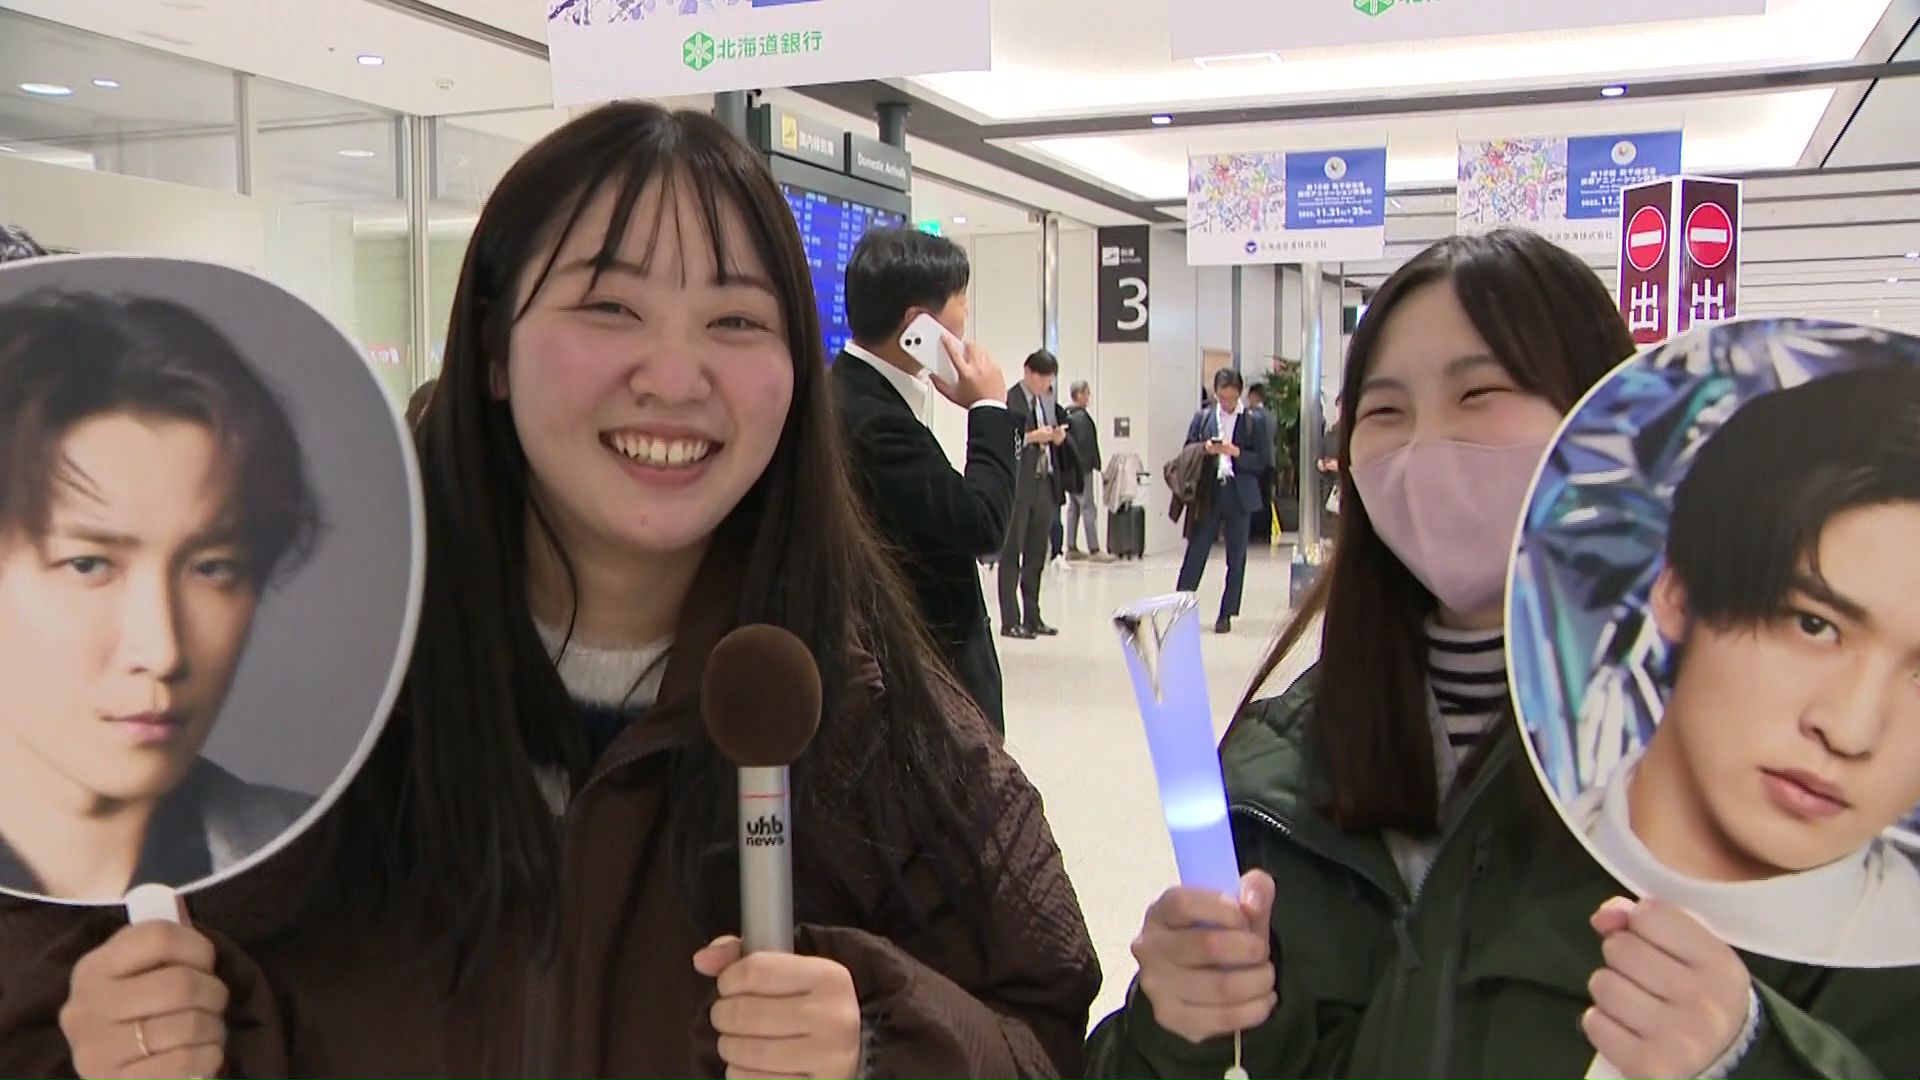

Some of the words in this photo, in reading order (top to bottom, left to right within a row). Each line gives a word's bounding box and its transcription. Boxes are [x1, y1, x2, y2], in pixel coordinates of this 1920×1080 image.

[716, 30, 823, 59] 北海道銀行
[1117, 277, 1147, 330] 3
[1629, 281, 1658, 331] 出
[746, 814, 783, 835] uhb
[746, 836, 784, 847] news
